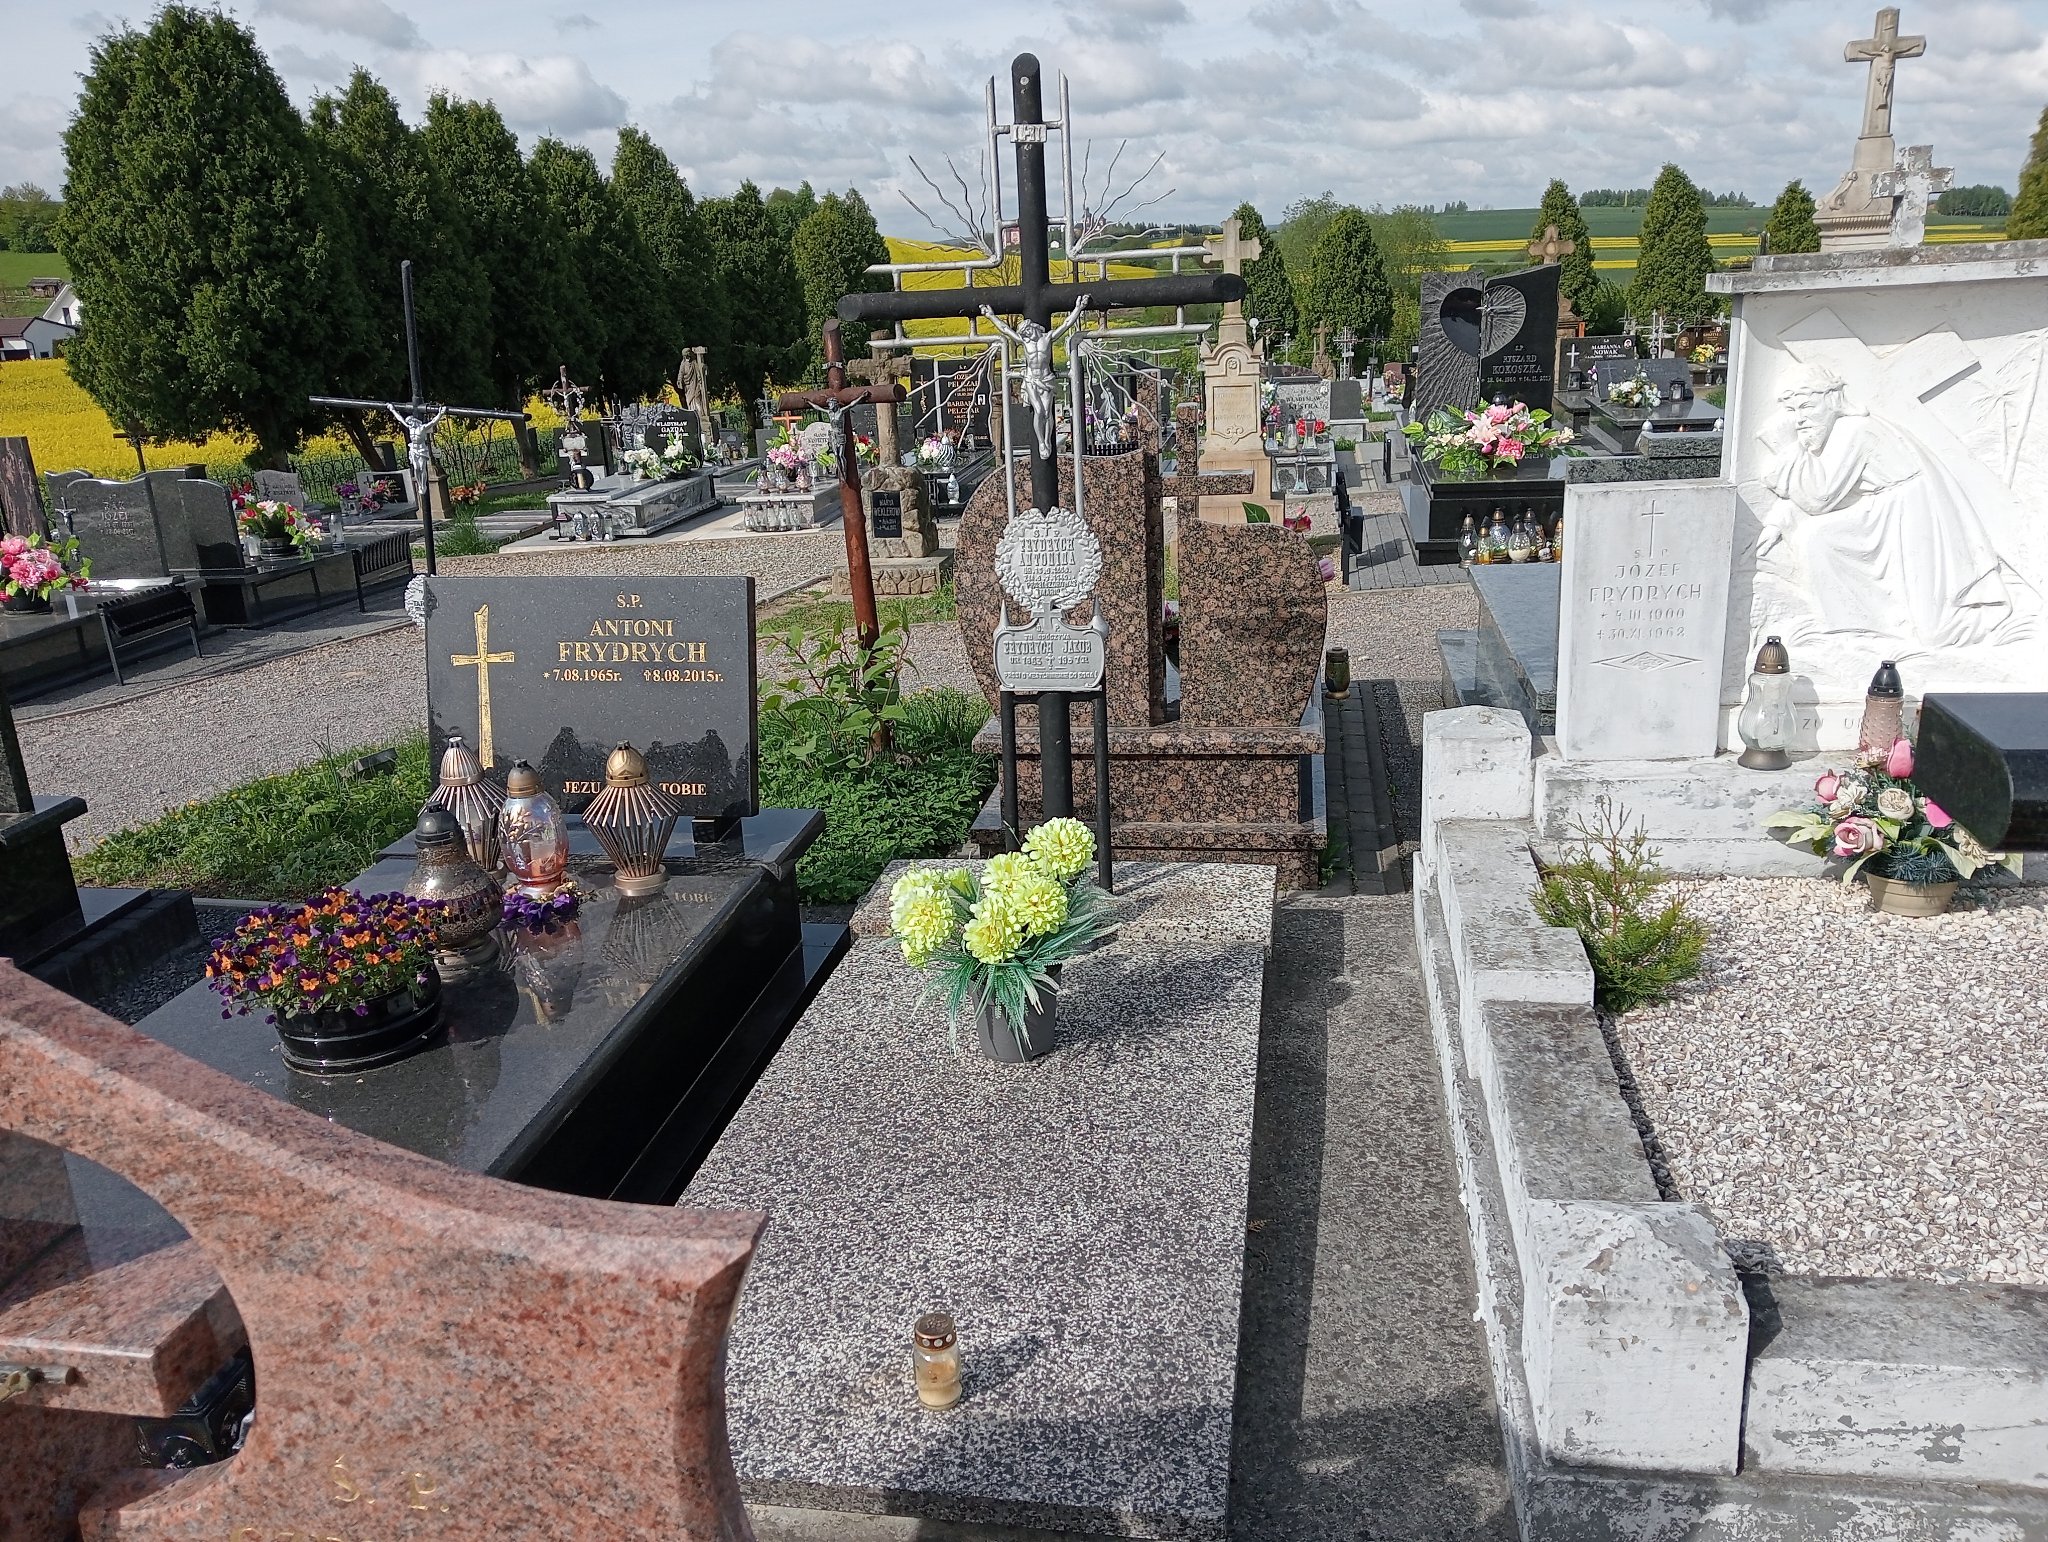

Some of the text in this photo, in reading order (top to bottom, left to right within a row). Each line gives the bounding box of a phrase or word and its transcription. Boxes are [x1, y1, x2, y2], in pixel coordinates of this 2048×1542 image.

[1502, 354, 1538, 363] RYSZARD
[1492, 364, 1544, 375] KOKOSZKA
[1019, 537, 1075, 552] FRYDRYCH
[1019, 551, 1076, 567] ANTONINA
[1615, 562, 1681, 579] JÓZEF
[1590, 583, 1702, 602] FRYDRYCH
[589, 618, 675, 637] ANTONI
[557, 640, 708, 663] FRYDRYCH
[1003, 639, 1092, 655] FRYDRYCH JAKUB
[562, 781, 708, 796] JEZU TOBIE
